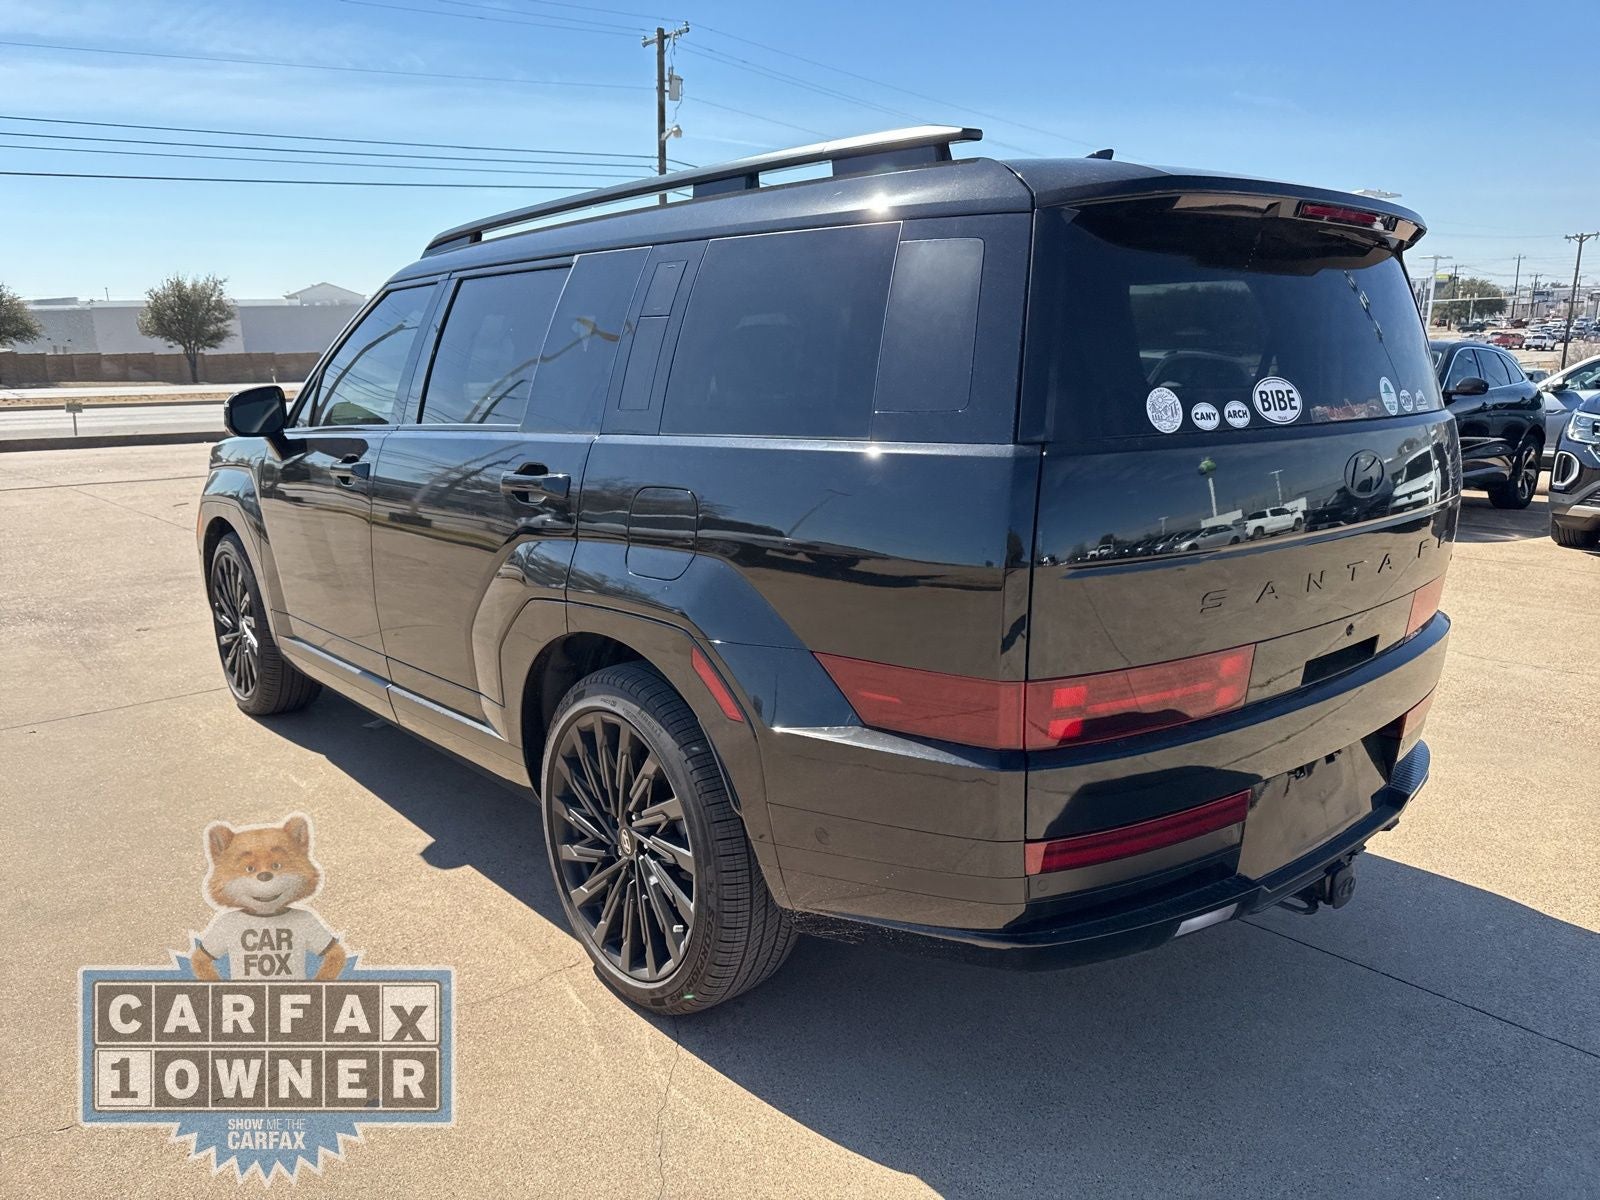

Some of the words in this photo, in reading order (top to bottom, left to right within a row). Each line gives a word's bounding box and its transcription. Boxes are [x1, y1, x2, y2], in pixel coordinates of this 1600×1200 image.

[1258, 389, 1298, 413] BIBE
[1194, 411, 1217, 421] CANY
[1227, 409, 1248, 419] ARCH
[1199, 553, 1394, 614] SANTA
